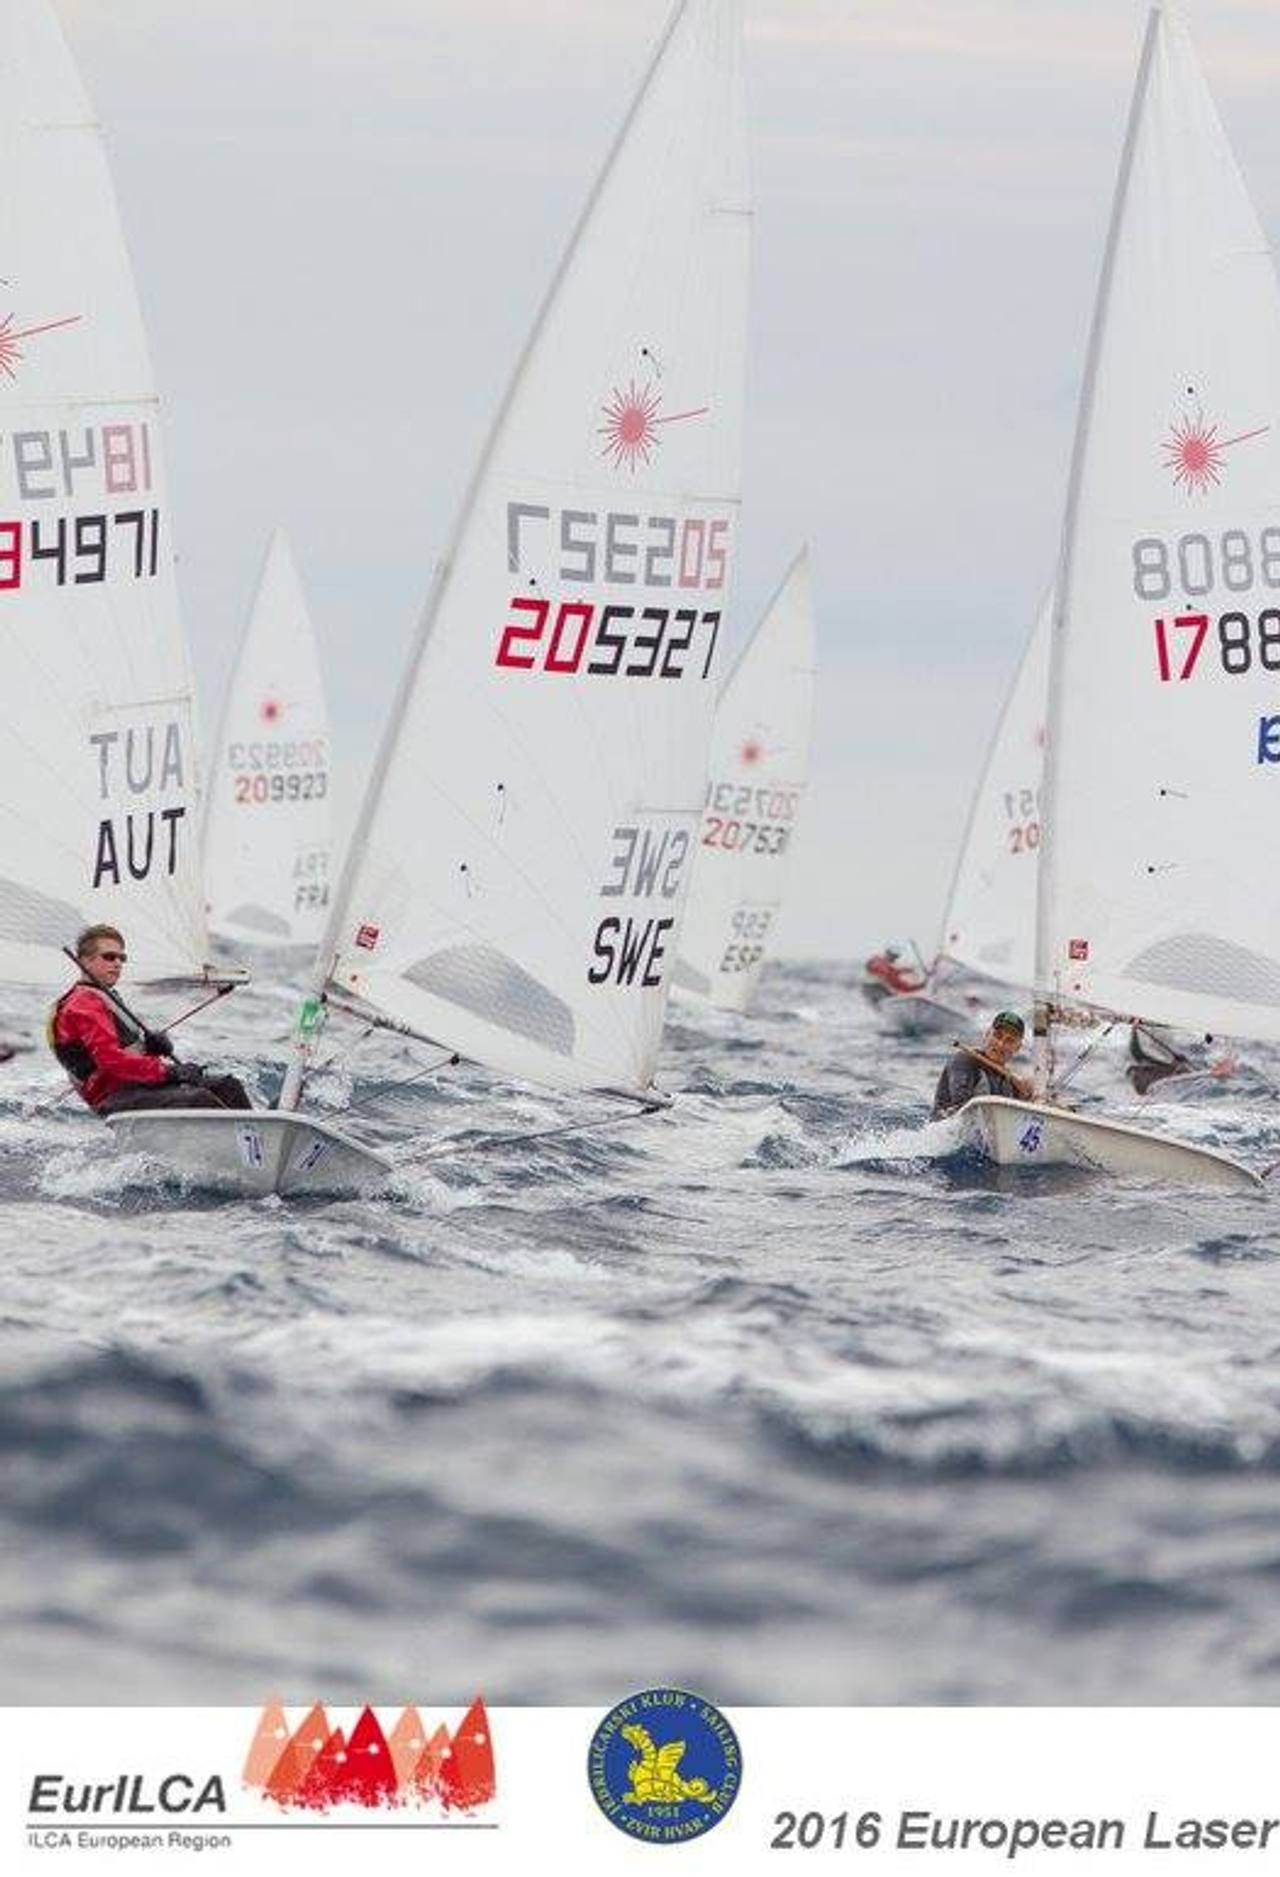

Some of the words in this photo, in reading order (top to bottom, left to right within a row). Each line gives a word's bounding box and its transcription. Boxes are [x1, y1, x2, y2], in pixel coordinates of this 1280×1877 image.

[496, 597, 721, 680] 205327
[234, 772, 328, 804] 209923
[93, 807, 186, 888] AUT
[588, 916, 674, 988] SWE
